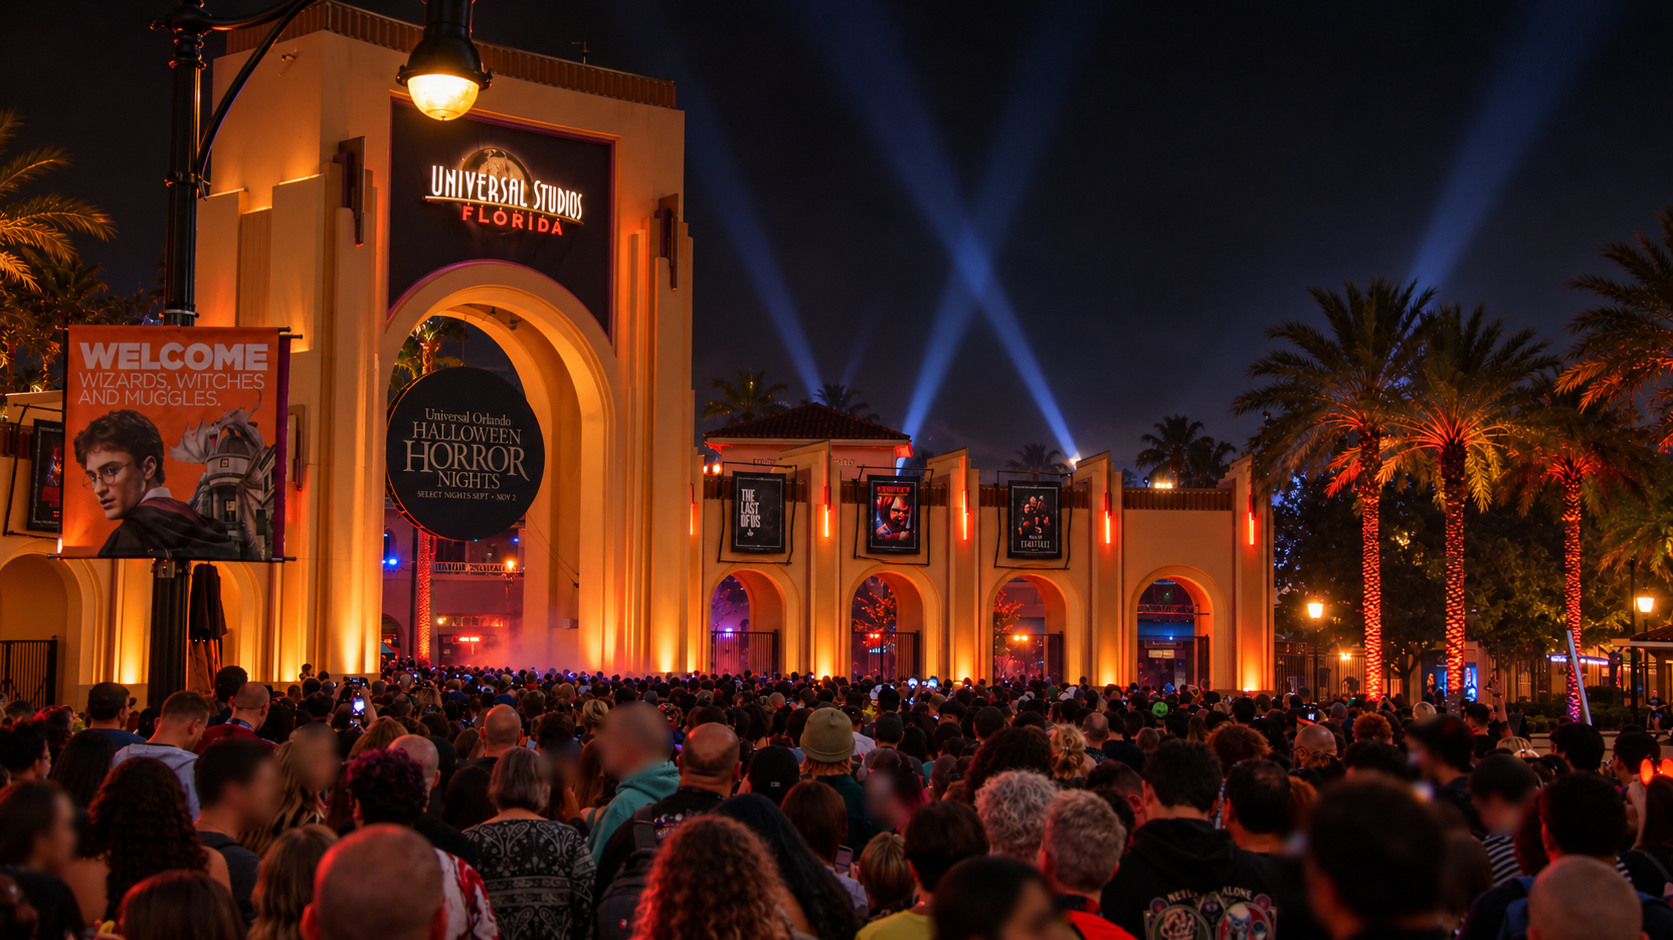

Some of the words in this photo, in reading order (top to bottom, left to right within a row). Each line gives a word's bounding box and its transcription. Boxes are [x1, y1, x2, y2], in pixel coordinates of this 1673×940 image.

[431, 165, 528, 207] UNIVERSAL
[533, 180, 583, 220] STUDIOS
[461, 205, 563, 235] FLORIDA
[79, 342, 268, 371] WELCOME
[79, 372, 171, 391] WIZARDS,
[175, 373, 265, 390] WITCHES
[77, 390, 120, 405] AND
[125, 390, 221, 406] MUGGLES.
[425, 407, 470, 423] Universal
[472, 411, 512, 427] Orlando
[412, 421, 522, 445] HALLOWEEN
[403, 439, 530, 482] HORROR
[437, 470, 500, 490] NIGHTS
[417, 490, 442, 498] SELECT
[444, 491, 471, 500] NIGHTS
[496, 493, 511, 501] NOV
[741, 488, 755, 502] THE
[740, 501, 760, 515] LAST
[1222, 886, 1252, 900] ALONE
